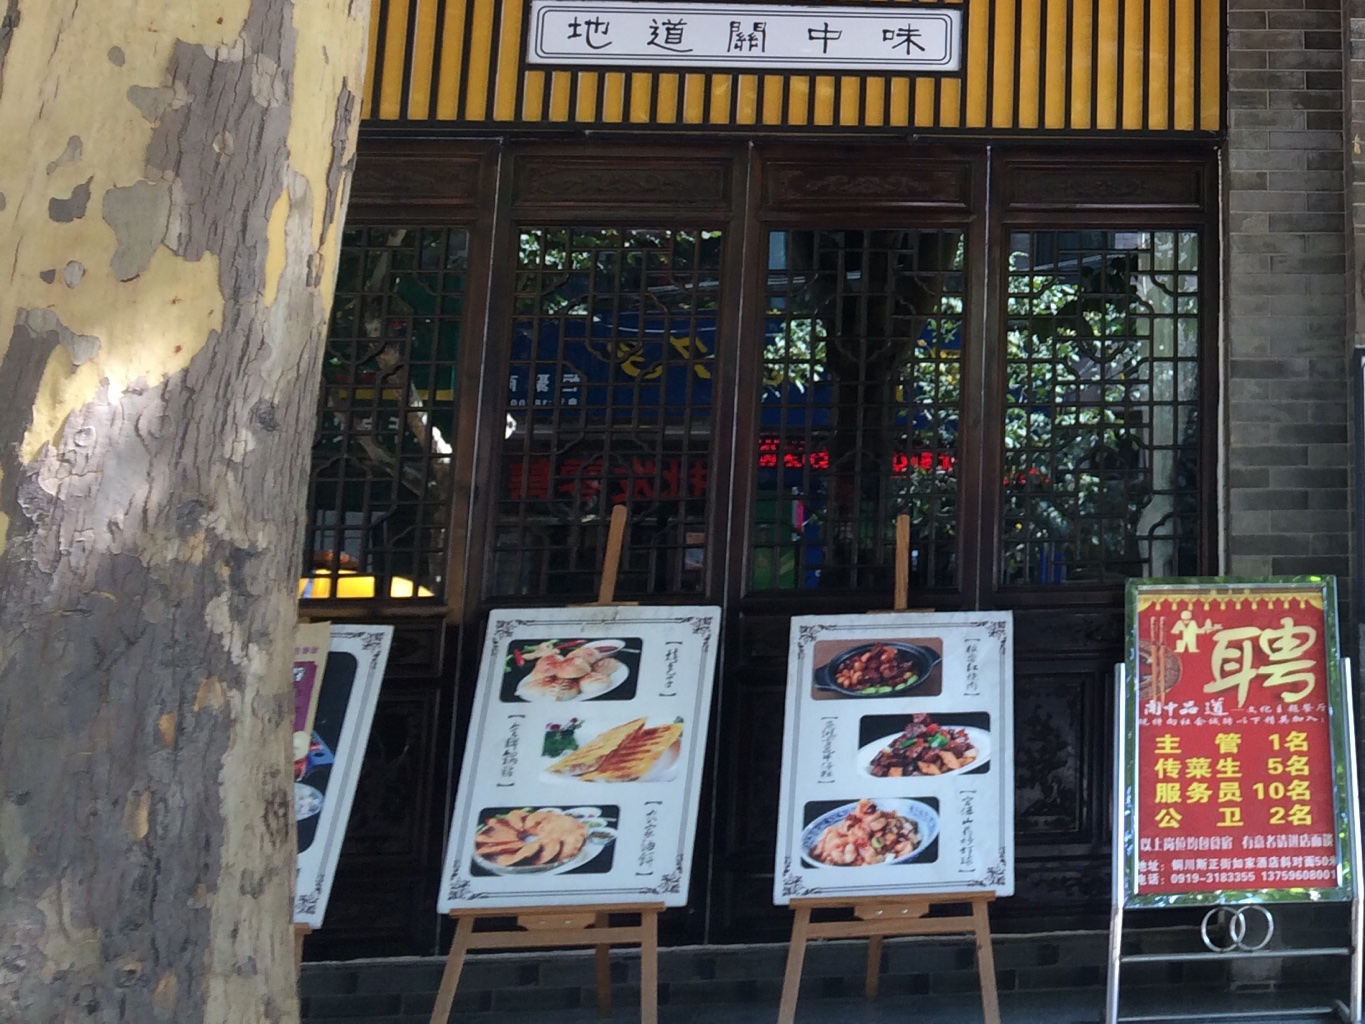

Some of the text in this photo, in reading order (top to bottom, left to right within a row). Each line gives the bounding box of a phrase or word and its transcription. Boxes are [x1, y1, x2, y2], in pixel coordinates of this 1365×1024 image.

[566, 17, 927, 56] 地道關中味
[1203, 617, 1317, 708] 聘
[1154, 757, 1243, 779] 传菜生
[1154, 781, 1243, 804] 服务员
